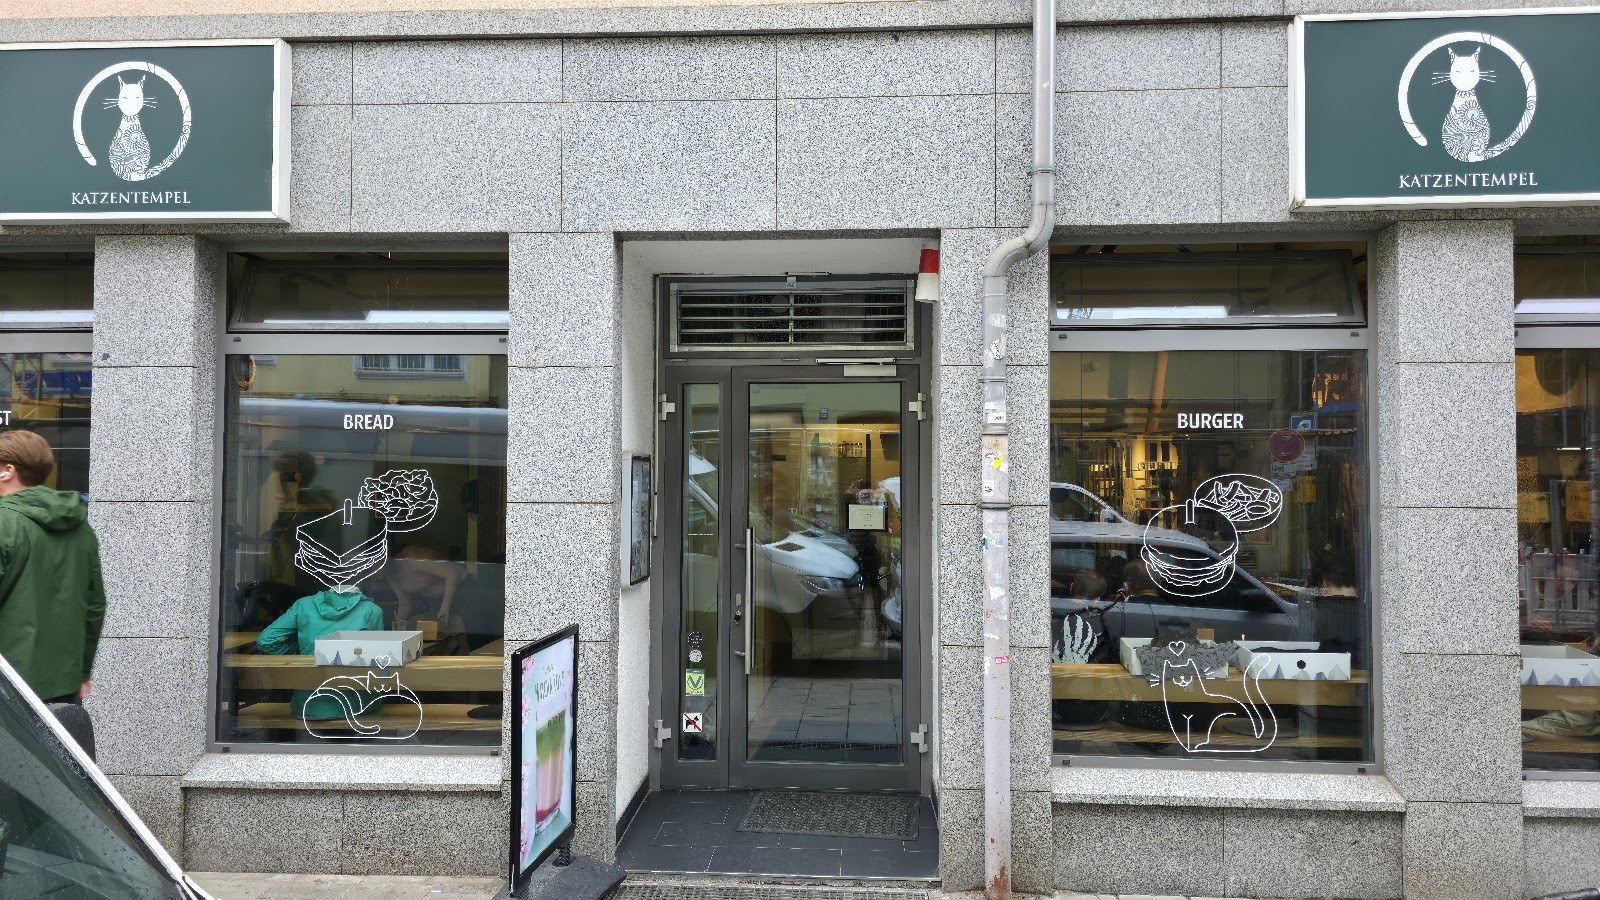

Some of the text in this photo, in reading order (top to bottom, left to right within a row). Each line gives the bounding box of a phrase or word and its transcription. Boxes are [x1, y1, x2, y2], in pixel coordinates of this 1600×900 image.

[1398, 172, 1539, 188] KATZENTEMPEL
[71, 191, 191, 205] KATZENTEMPEL
[343, 414, 394, 430] BREAD
[1177, 413, 1244, 429] BURGER
